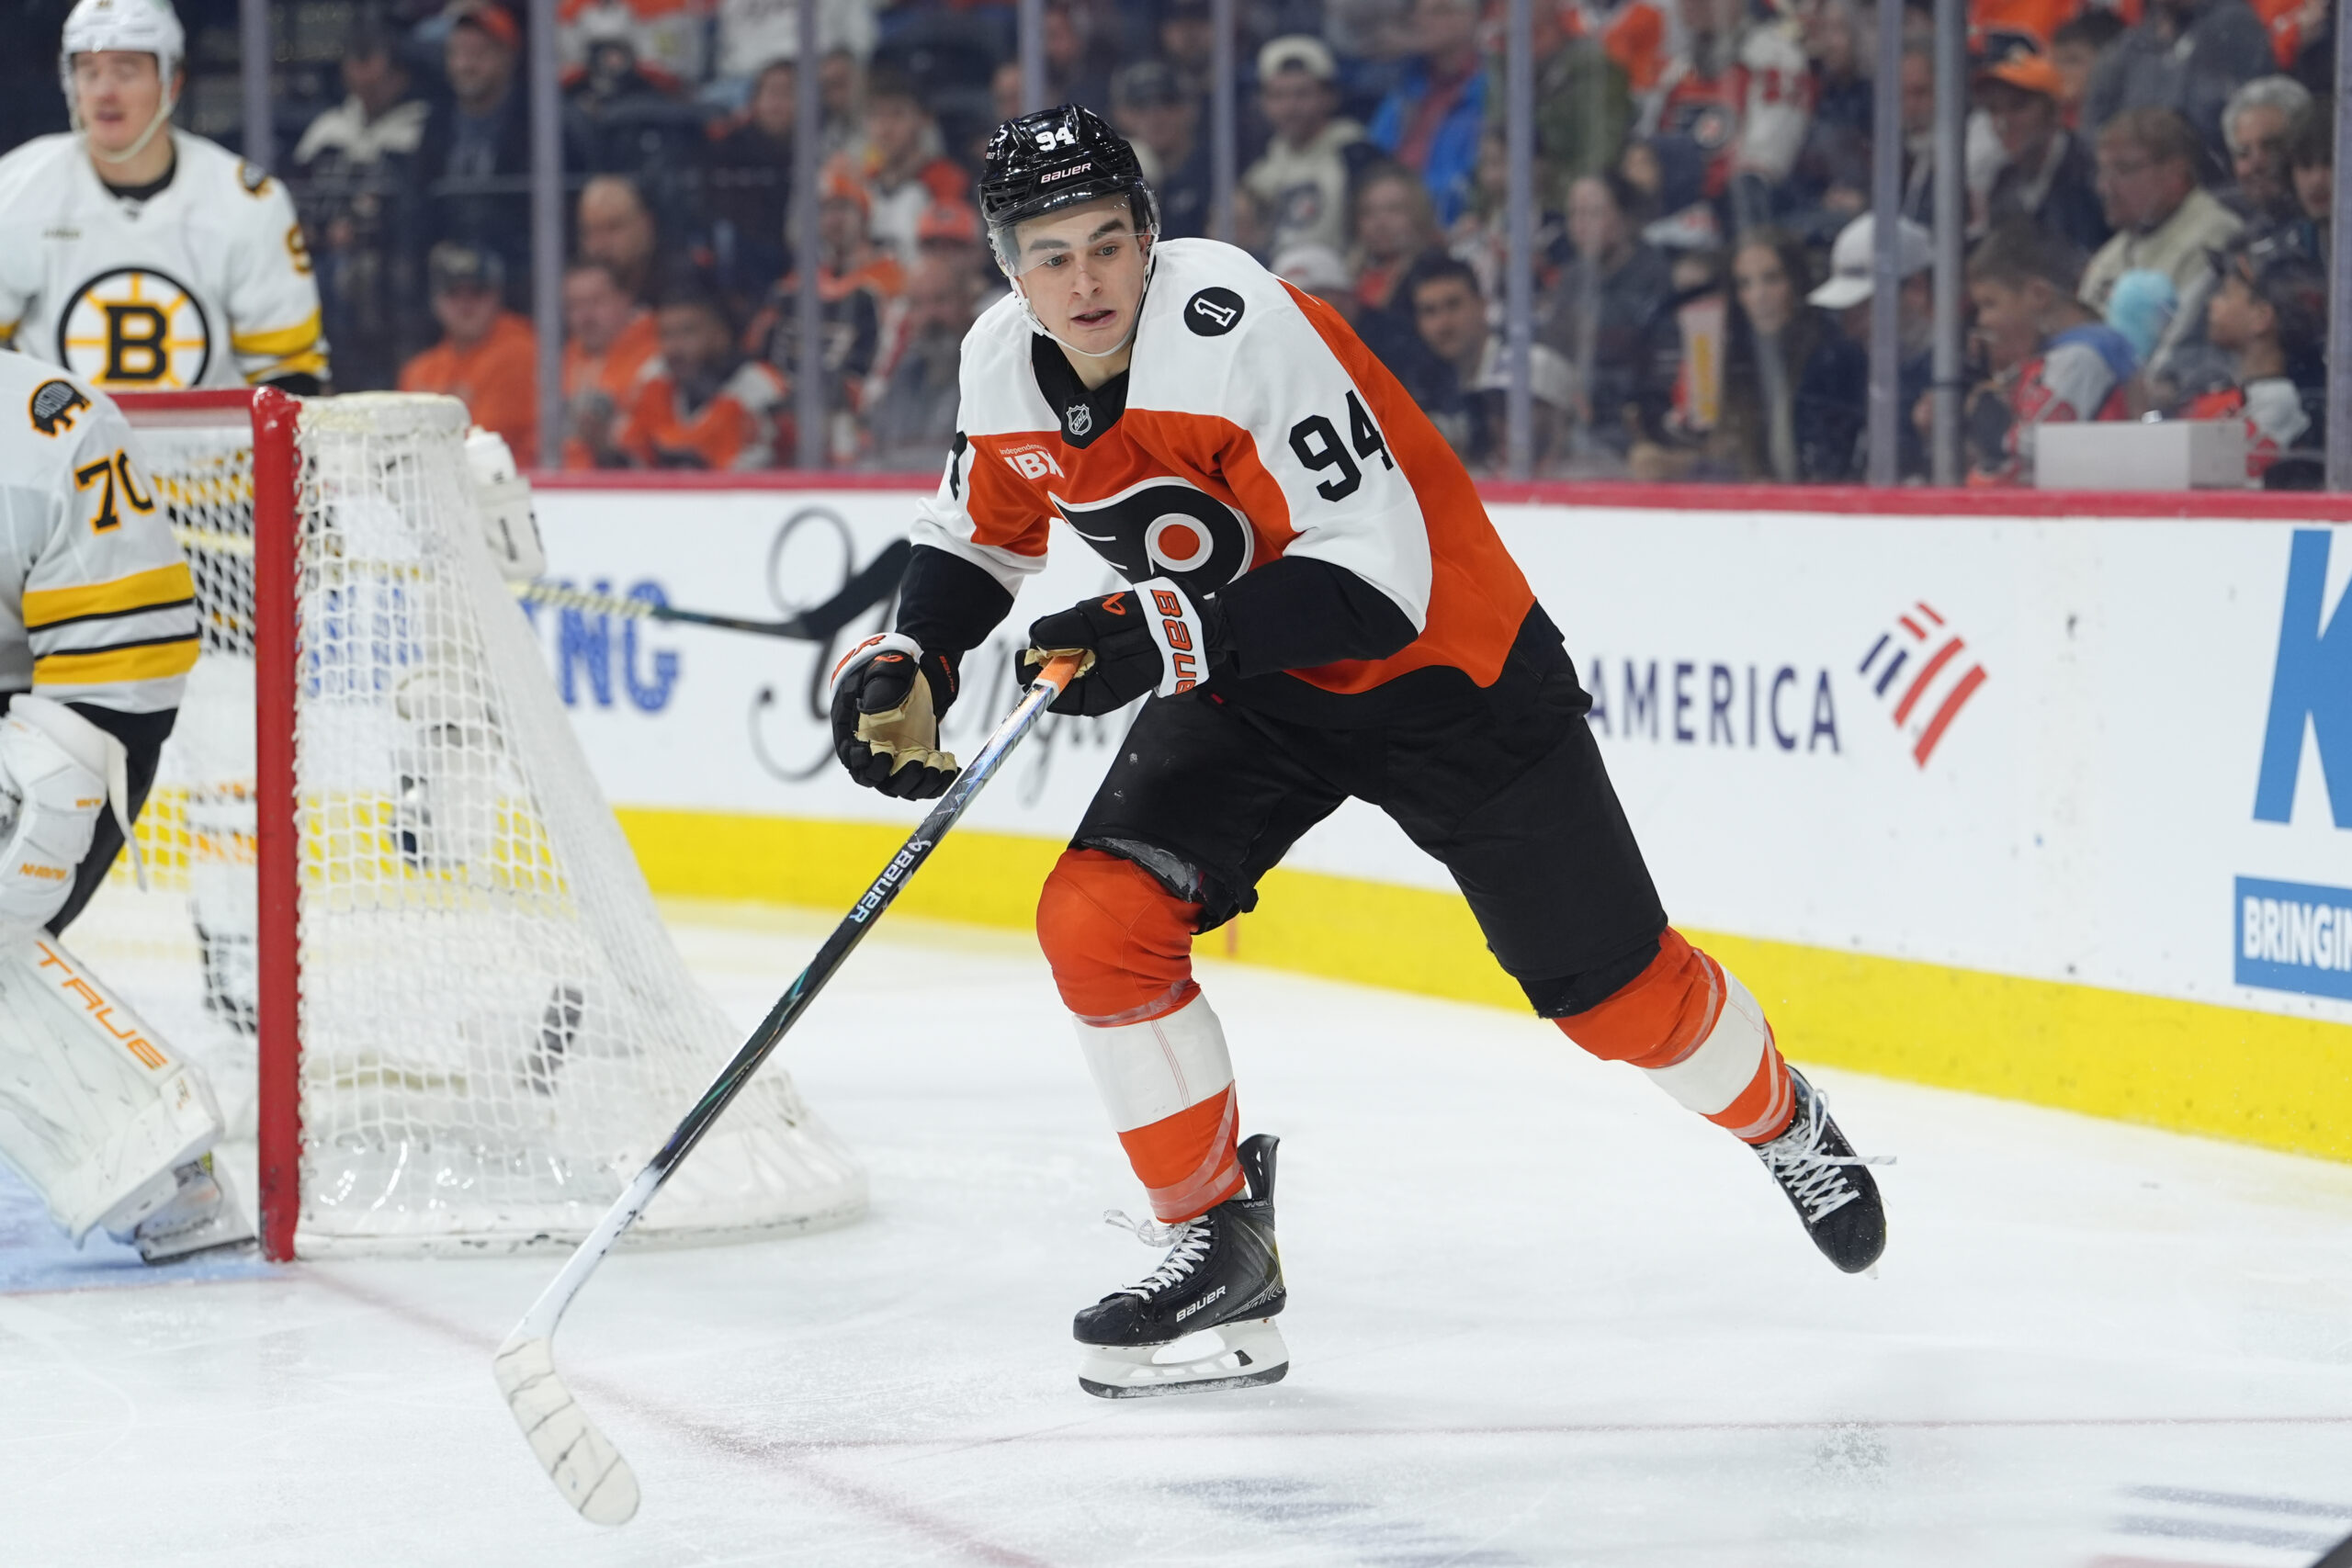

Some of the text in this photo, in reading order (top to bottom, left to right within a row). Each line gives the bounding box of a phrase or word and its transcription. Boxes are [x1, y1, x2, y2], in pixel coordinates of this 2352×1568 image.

[1035, 126, 1076, 152] 94
[1041, 163, 1091, 184] BAUER
[1193, 297, 1237, 327] 1
[105, 304, 168, 380] B
[1073, 412, 1087, 433] NHL
[1289, 389, 1395, 502] 94
[1587, 656, 1840, 755] AMERICA
[849, 850, 915, 923] BAUER
[35, 939, 169, 1071] TRUE
[1176, 1286, 1227, 1324] BAUER
